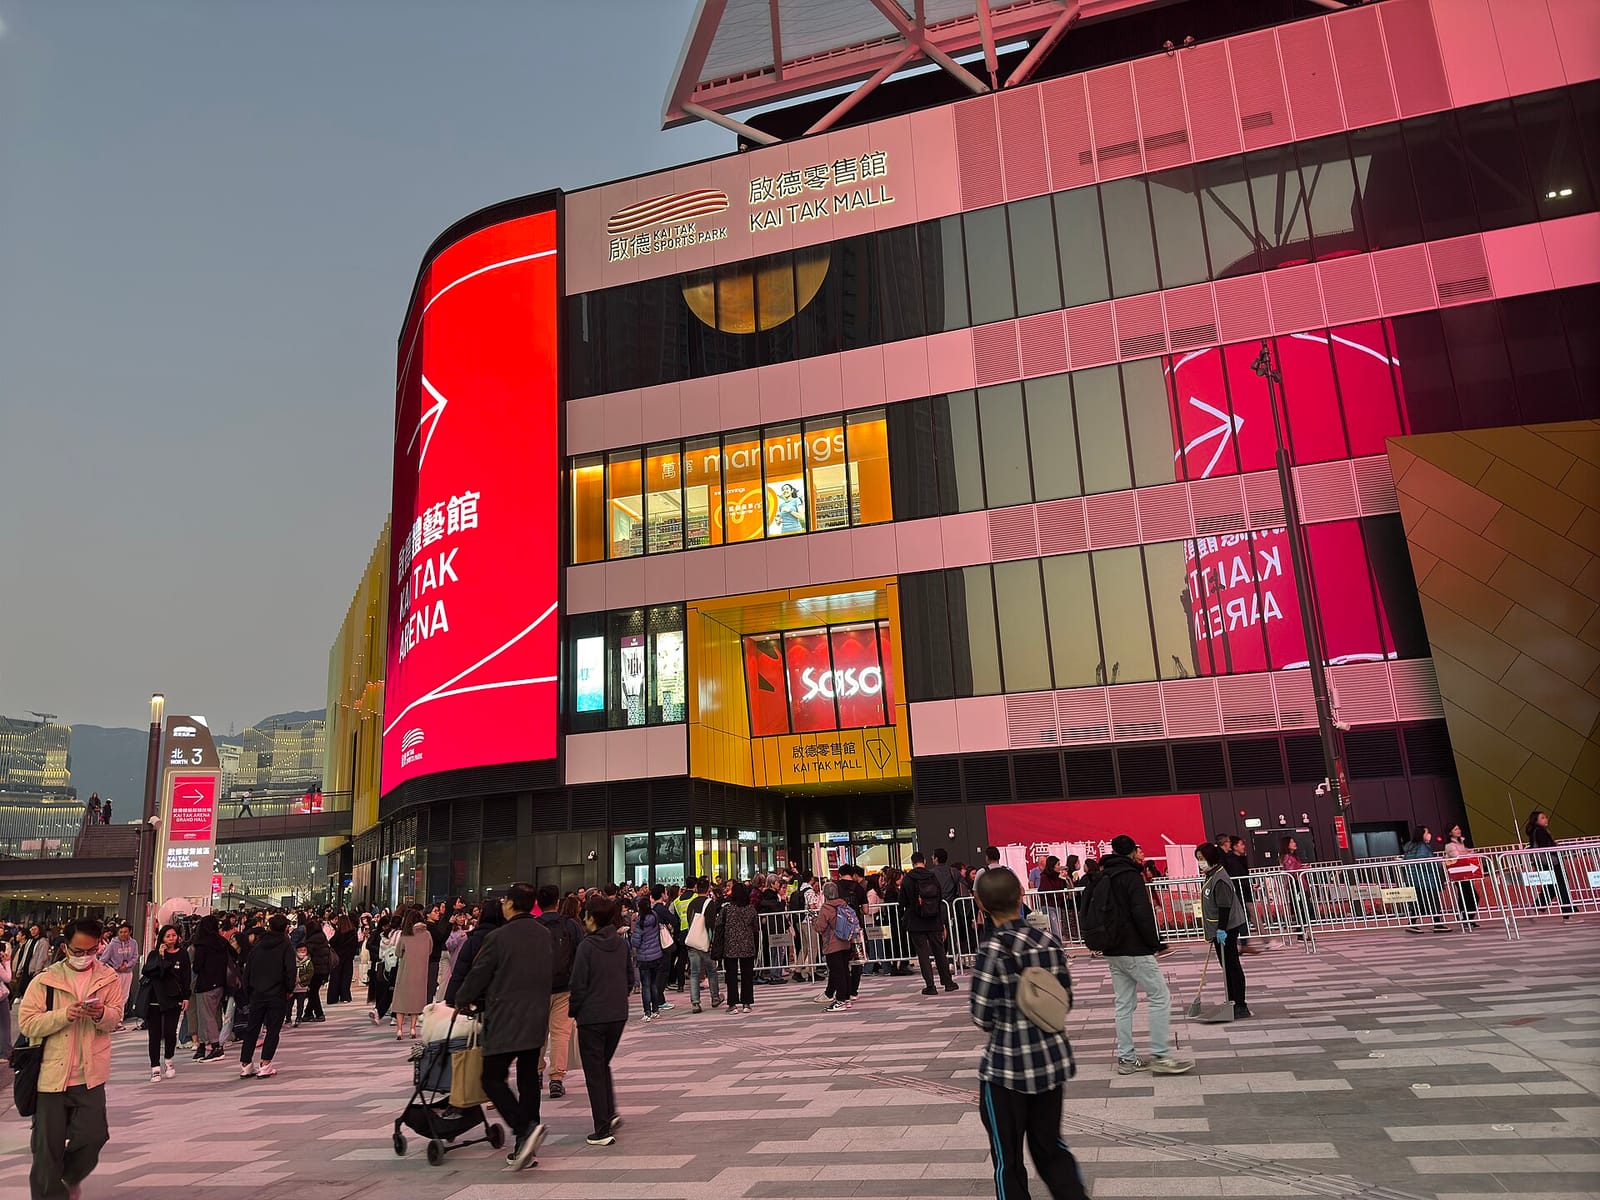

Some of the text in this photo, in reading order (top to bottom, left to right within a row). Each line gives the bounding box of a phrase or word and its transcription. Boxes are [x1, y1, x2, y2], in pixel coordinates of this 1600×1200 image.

[749, 150, 888, 203] 啟德零售館
[749, 184, 895, 232] KAI TAK MALL
[653, 222, 697, 241] KAI TAK
[653, 227, 728, 252] SPORTS PARK
[608, 232, 651, 262] 啟德
[703, 434, 845, 474] mannings
[413, 547, 459, 600] TAK
[398, 600, 449, 664] ARENA
[170, 747, 183, 759] 北
[191, 748, 203, 765] 3
[793, 759, 863, 773] KAI TAK MALL
